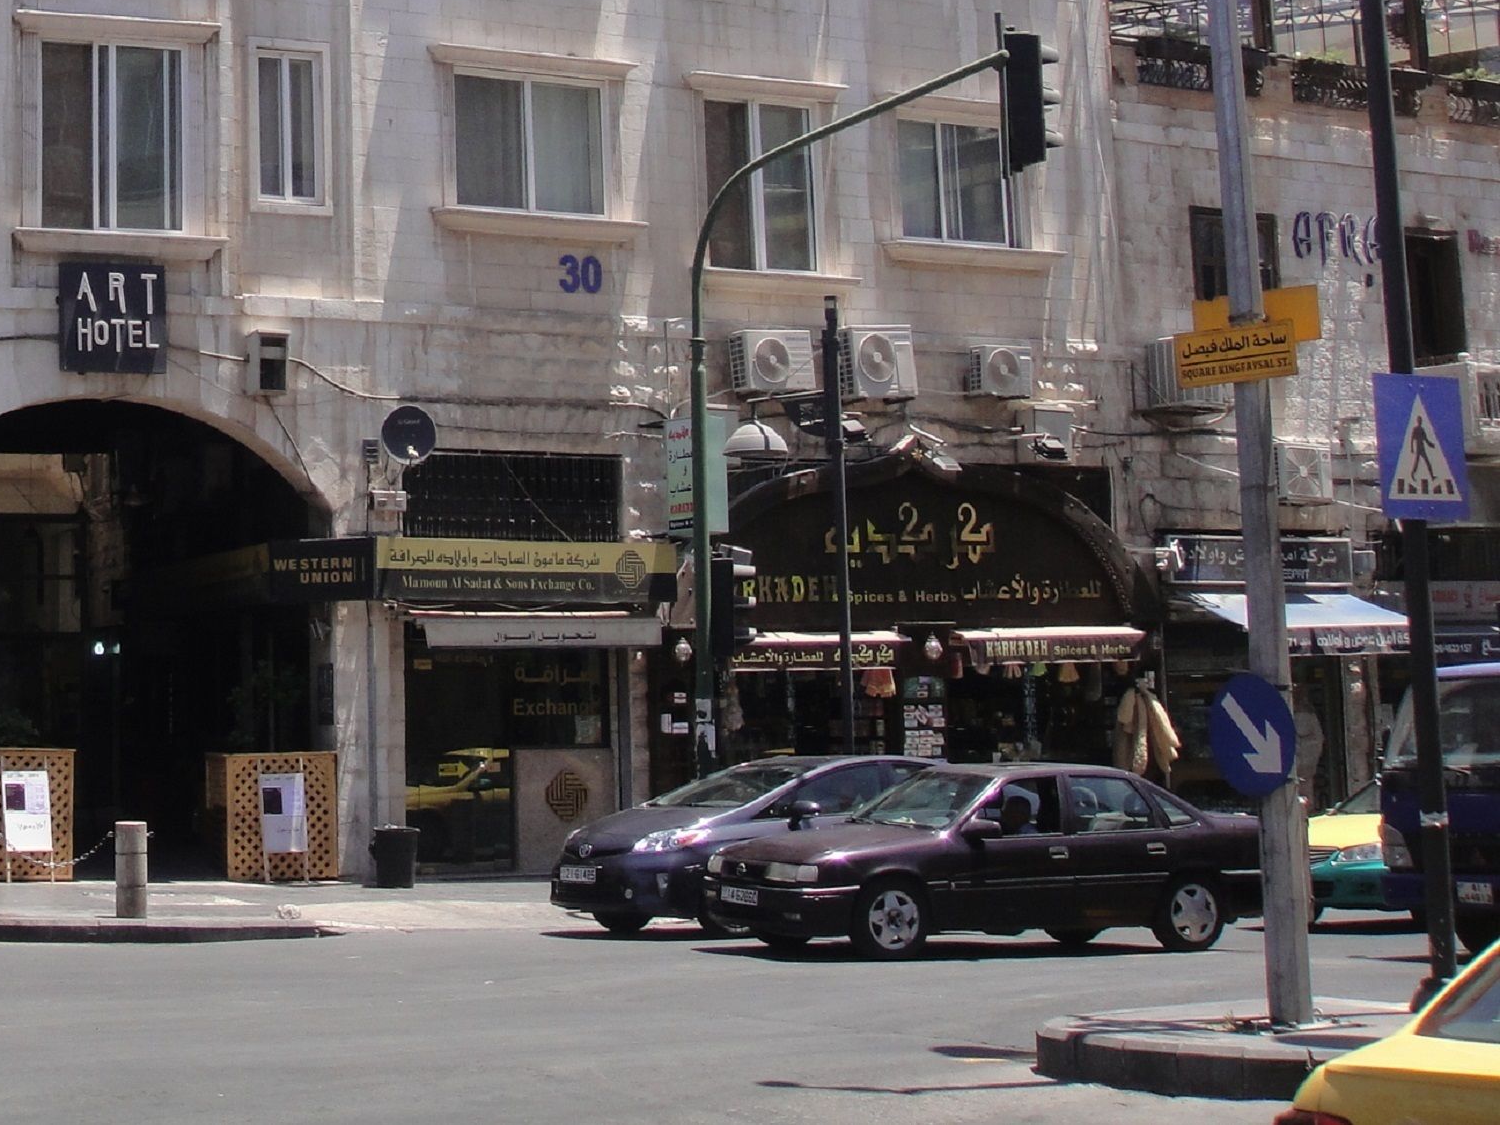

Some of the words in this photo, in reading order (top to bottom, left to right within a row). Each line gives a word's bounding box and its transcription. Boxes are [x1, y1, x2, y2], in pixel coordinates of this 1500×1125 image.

[558, 254, 602, 294] 30
[76, 271, 157, 315] ART
[77, 317, 160, 353] HOTEL
[1219, 335, 1250, 353] الملك
[1252, 332, 1287, 347] ساحة
[1181, 338, 1219, 359] فيصل
[273, 557, 354, 571] WESTERN
[566, 552, 600, 568] شركة
[299, 571, 354, 583] UNION
[402, 574, 448, 589] Mamoun
[463, 575, 492, 589] Sadat
[493, 578, 503, 589] &
[506, 578, 529, 590] Sons
[530, 578, 576, 592] Exchange
[734, 575, 839, 603] RKADEH
[915, 589, 957, 603] Herbs
[1053, 645, 1088, 656] Spices
[1101, 644, 1131, 655] Herbs
